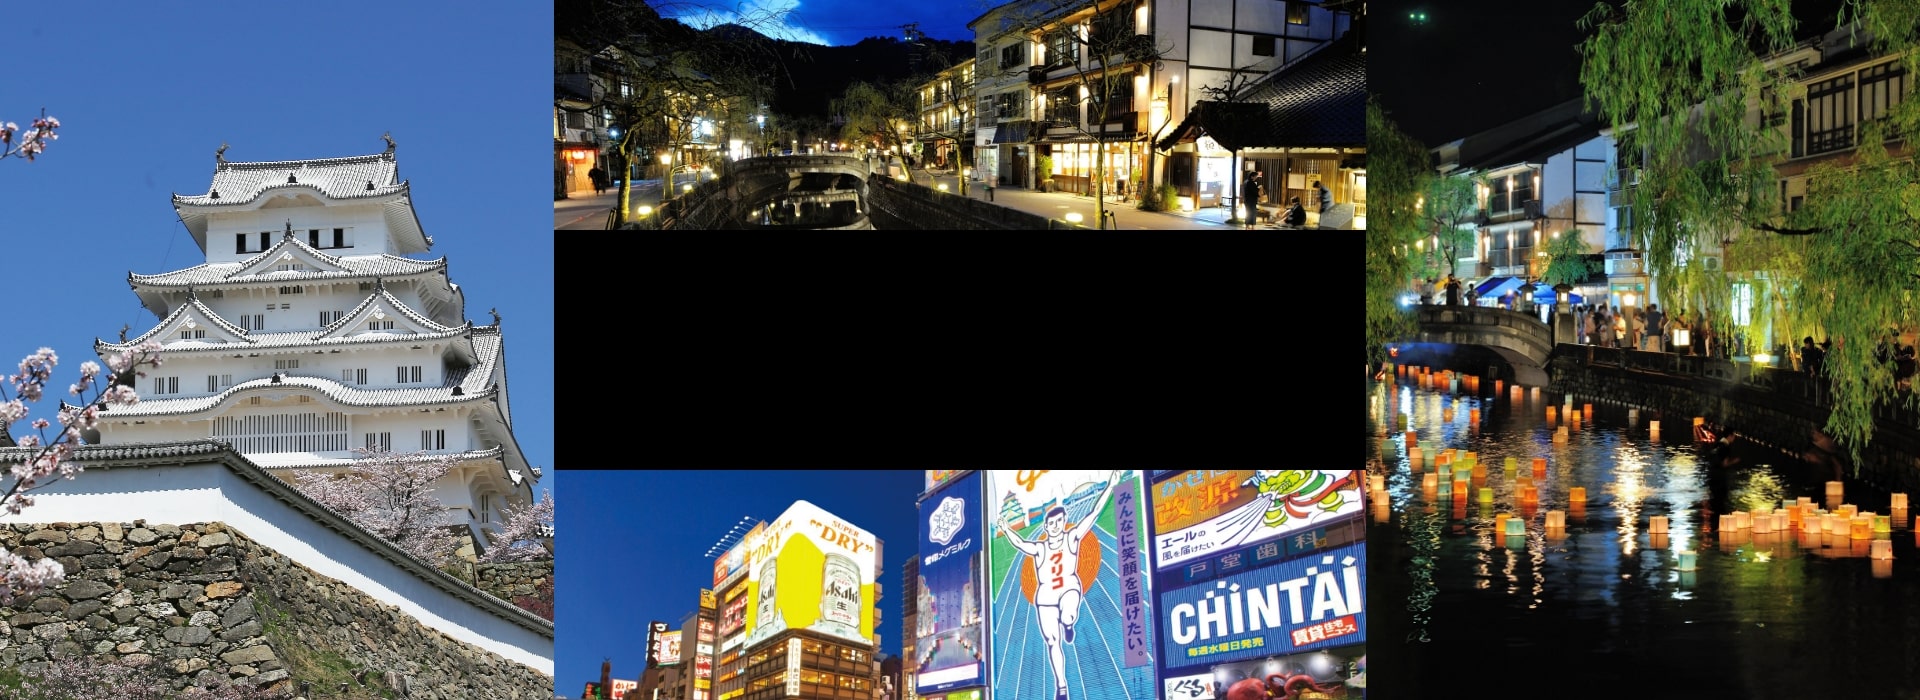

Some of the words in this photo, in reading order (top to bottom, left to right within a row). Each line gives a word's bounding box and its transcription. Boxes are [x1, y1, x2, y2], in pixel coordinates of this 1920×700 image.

[1155, 473, 1239, 526] 改源
[832, 520, 860, 538] SUPER
[1161, 530, 1206, 549] エールの
[1162, 541, 1215, 562] 風を届けたい
[1190, 531, 1317, 578] 戸堂歯科
[1050, 549, 1064, 590] グリコ
[1117, 490, 1144, 657] みんなに笑顔を届けたい。
[825, 580, 858, 605] Asahi
[836, 601, 847, 611] 生
[1292, 624, 1326, 646] 賃貸
[1188, 636, 1264, 657] 毎週水曜日発売
[1173, 679, 1206, 698] くくる
